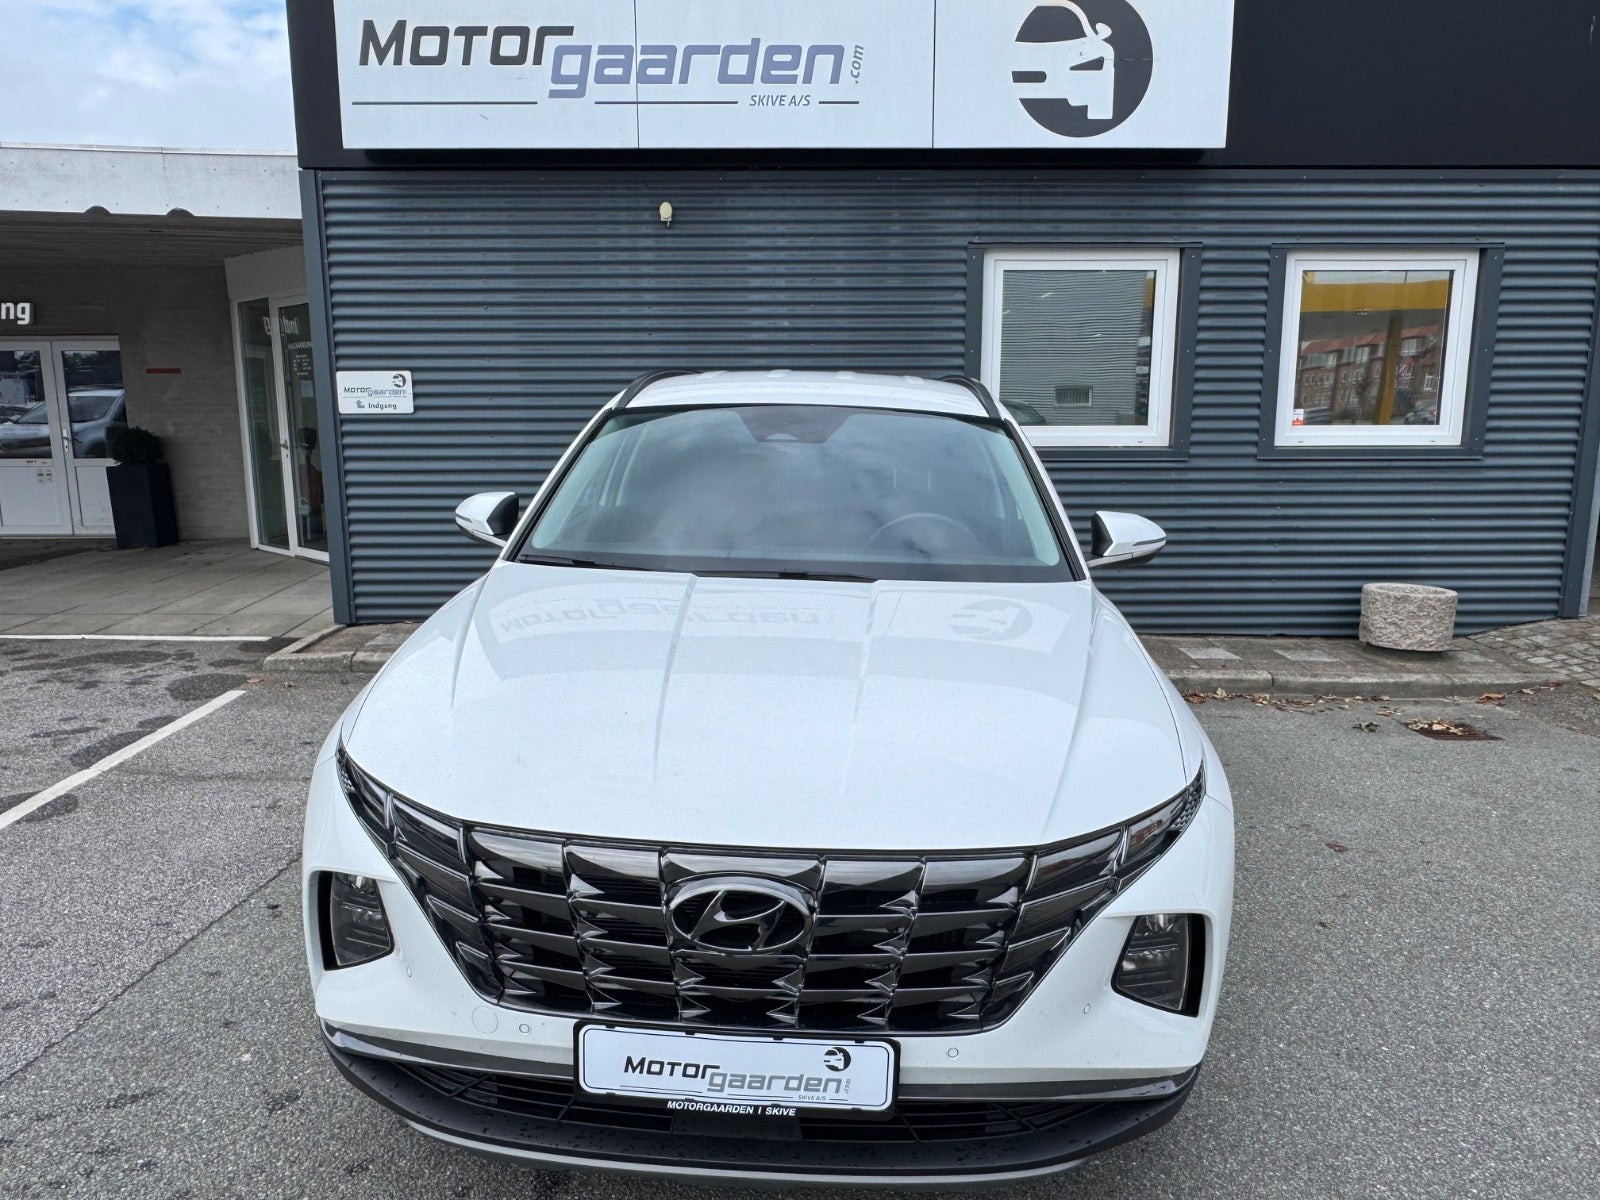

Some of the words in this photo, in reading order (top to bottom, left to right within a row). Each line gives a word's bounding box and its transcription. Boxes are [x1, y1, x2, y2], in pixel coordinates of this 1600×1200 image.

[850, 44, 864, 84] .com
[749, 94, 787, 107] SKIVE
[788, 94, 811, 107] A/S
[368, 402, 397, 411] Indgang
[666, 1100, 754, 1115] MOTORGAARDEN
[765, 1106, 797, 1117] SKIVE
